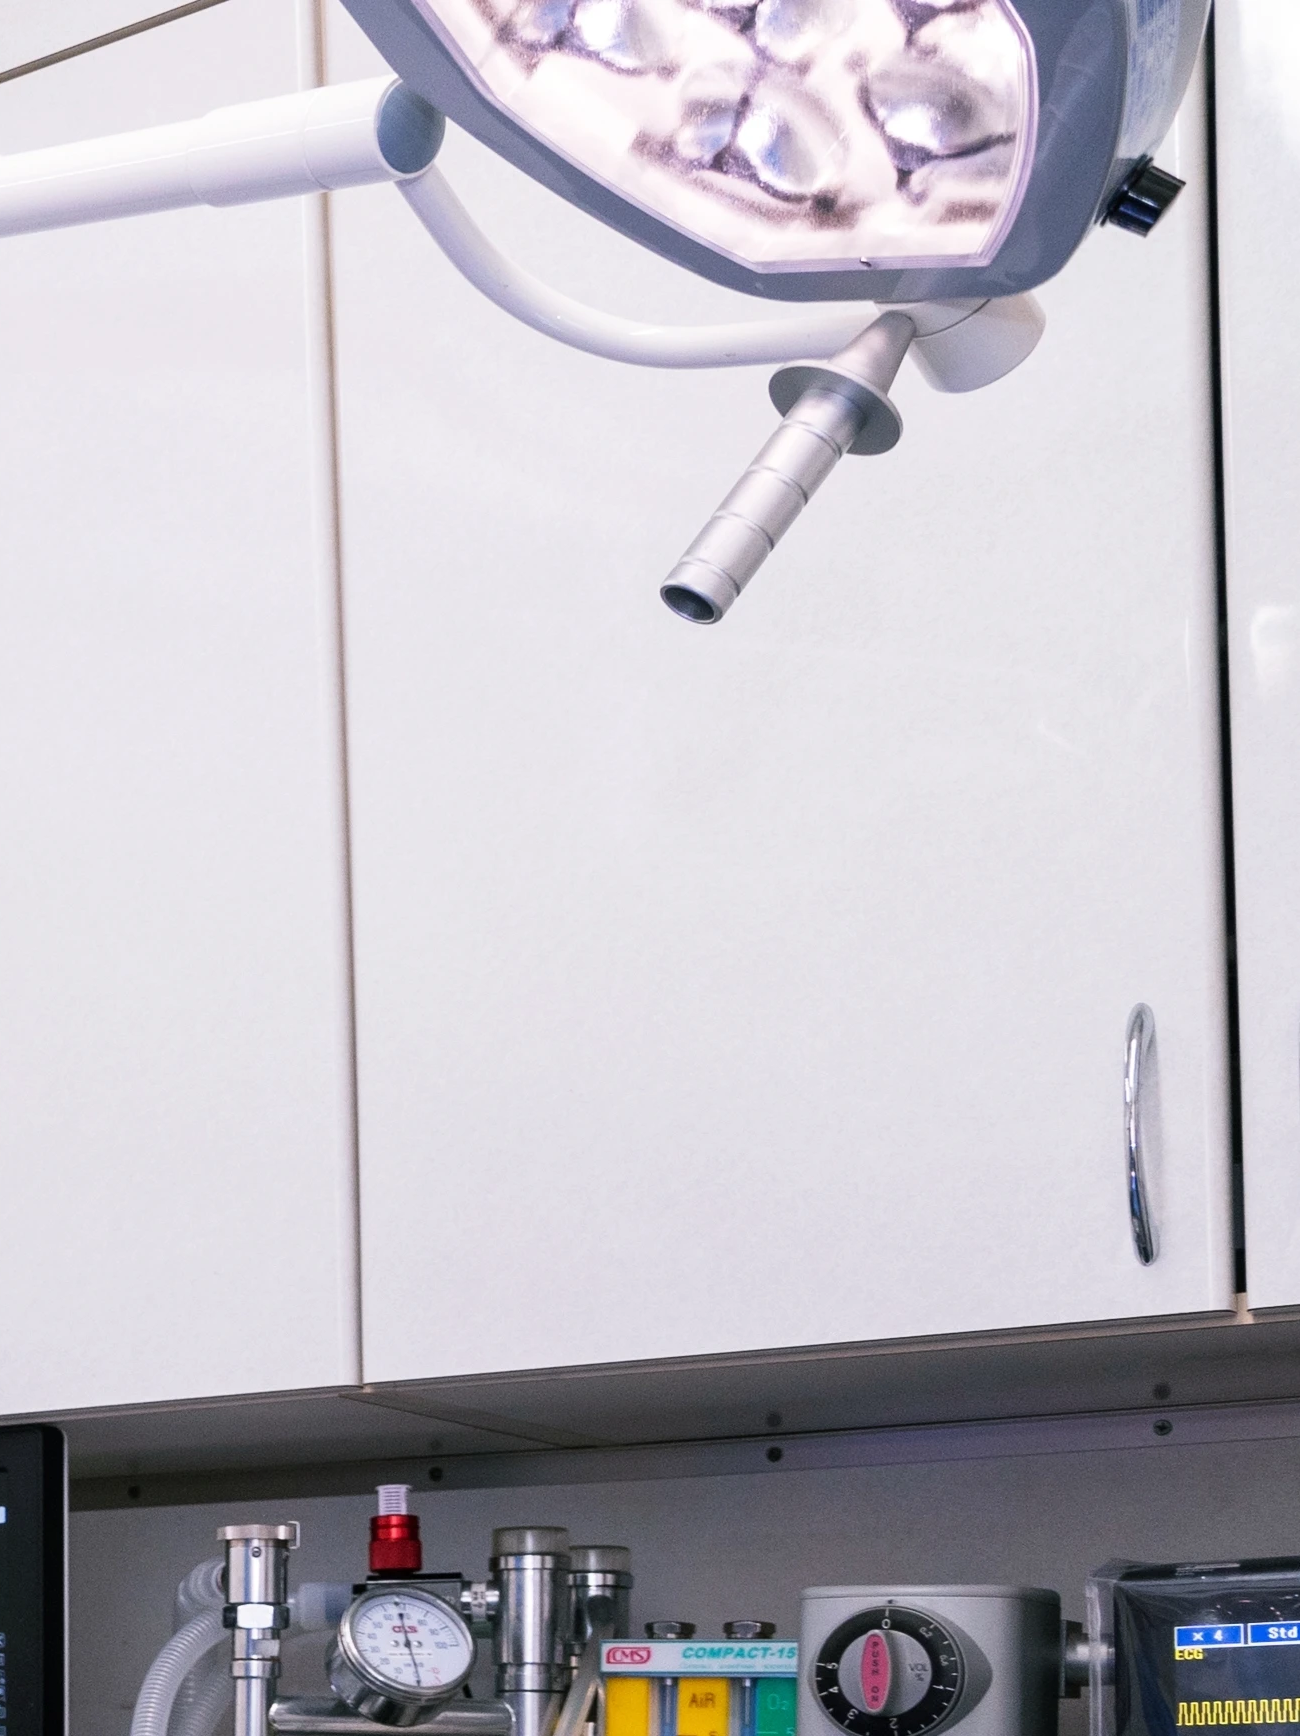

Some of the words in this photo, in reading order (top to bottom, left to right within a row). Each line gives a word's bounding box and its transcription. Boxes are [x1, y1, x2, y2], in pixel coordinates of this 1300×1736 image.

[881, 1618, 891, 1629] 0
[1213, 1630, 1223, 1641] 4
[1268, 1626, 1298, 1639] Std
[609, 1648, 648, 1663] CMS
[682, 1646, 797, 1659] COMPACT-15
[1174, 1649, 1204, 1661] ECG
[908, 1663, 929, 1673] VOL
[688, 1692, 717, 1708] AIR
[846, 1708, 859, 1720] 3
[889, 1718, 899, 1729] 2
